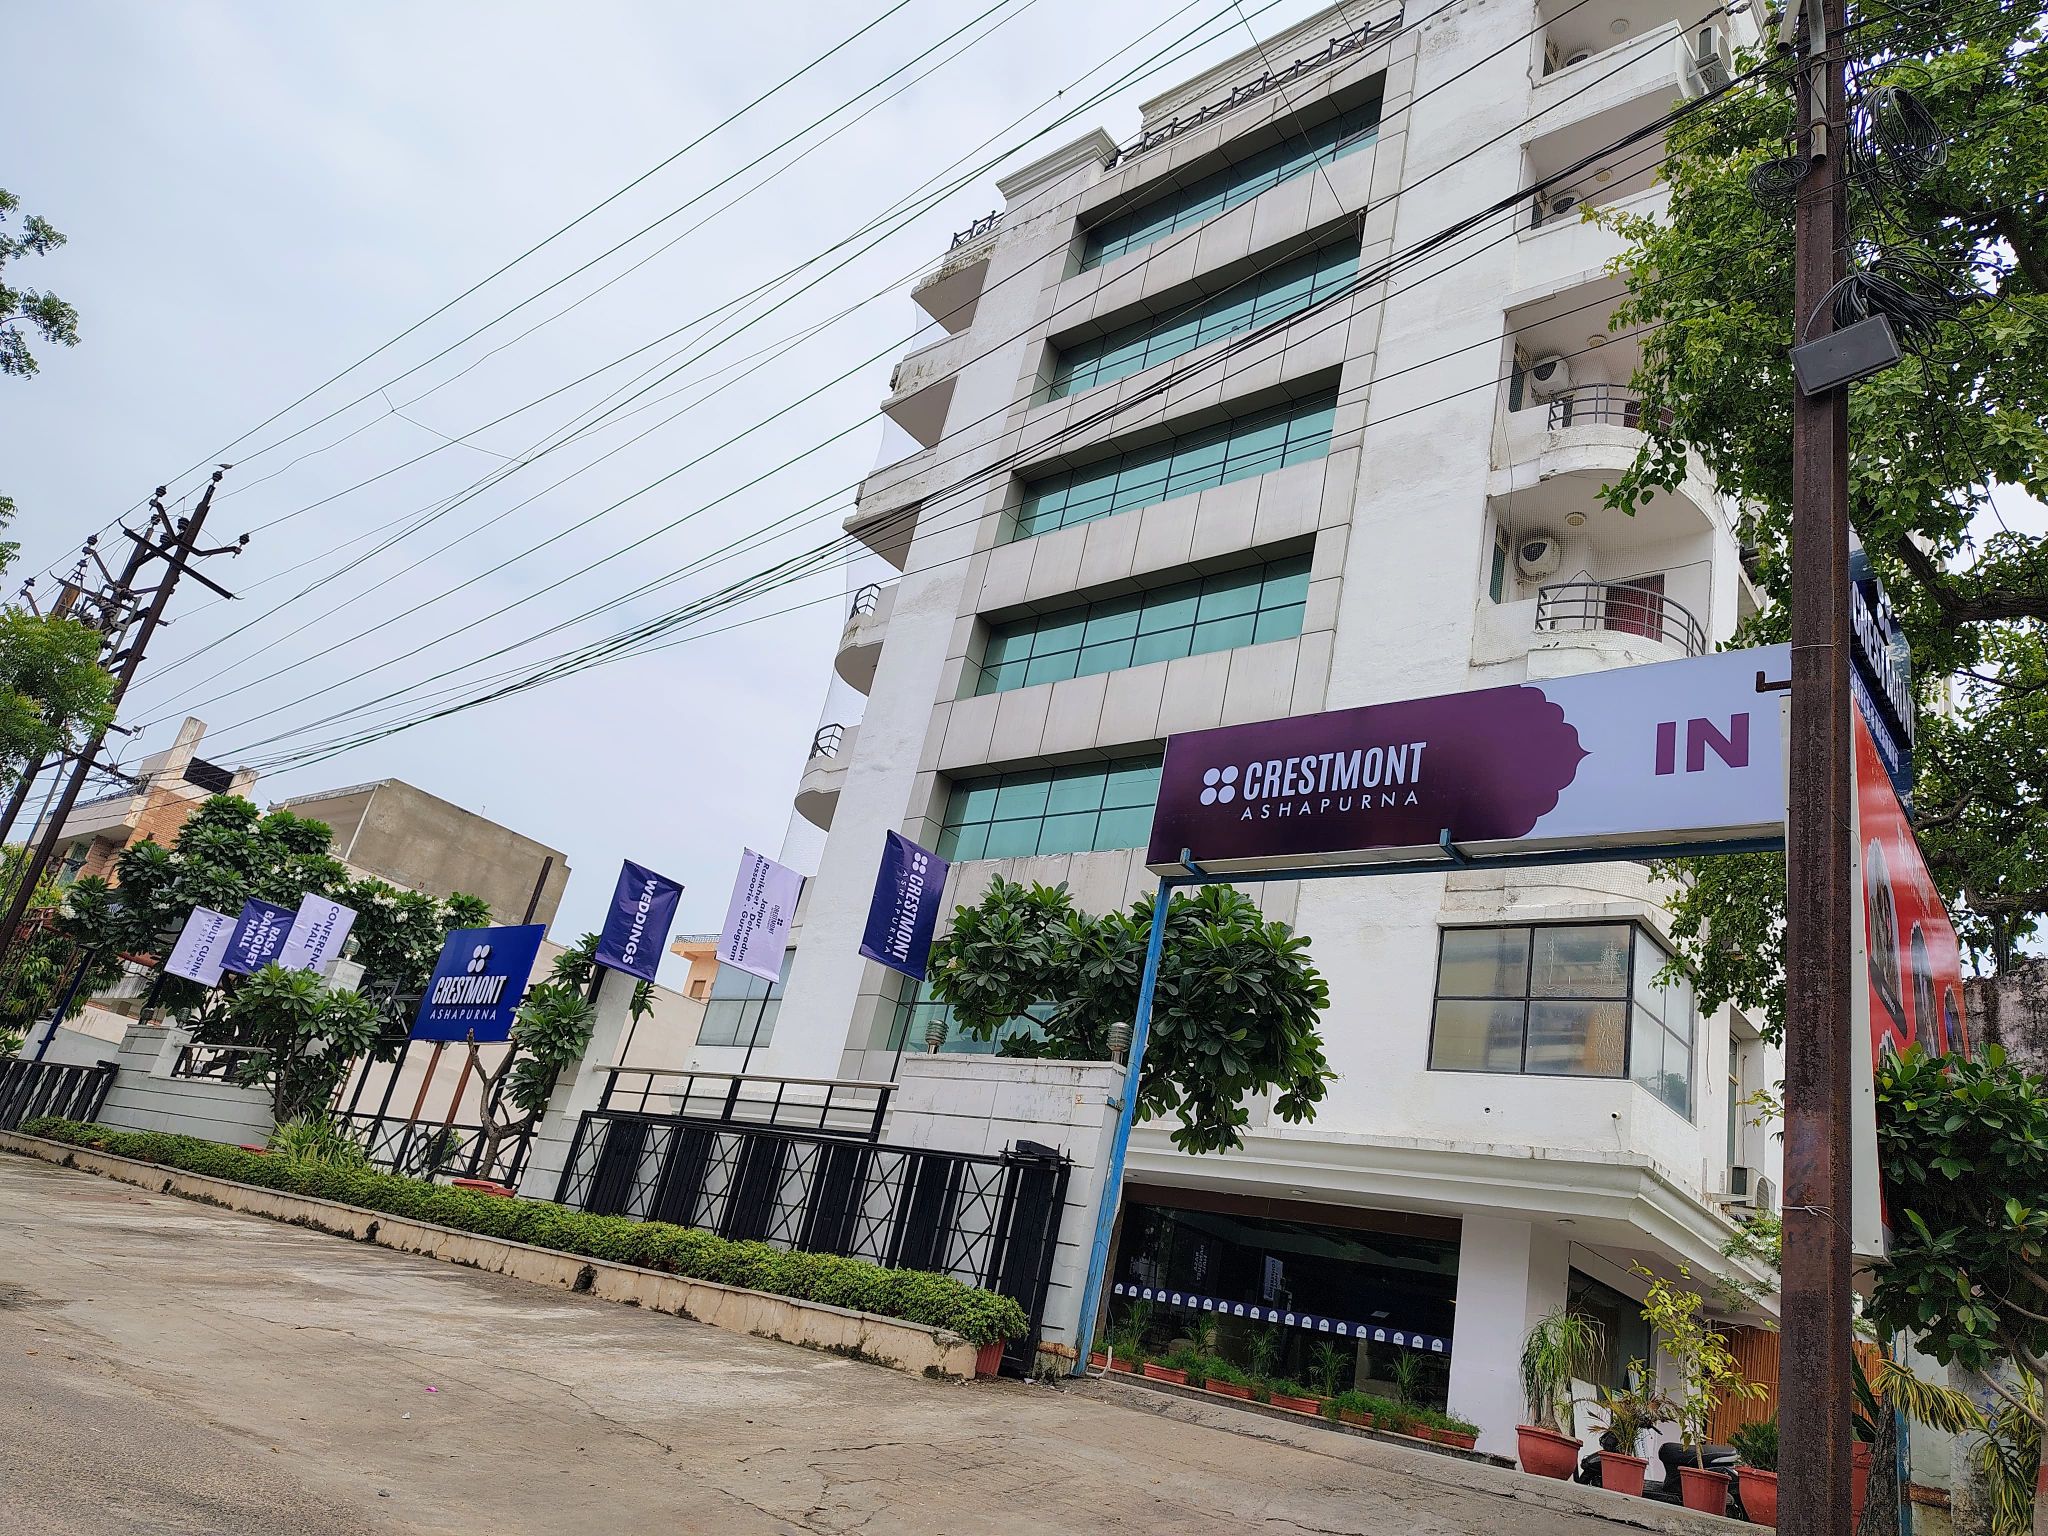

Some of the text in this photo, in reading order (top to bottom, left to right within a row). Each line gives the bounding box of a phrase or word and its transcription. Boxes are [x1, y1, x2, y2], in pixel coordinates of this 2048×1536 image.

[1243, 741, 1427, 801] CRESTMONT
[1655, 712, 1749, 776] IN
[1240, 790, 1419, 821] ASHAPURNA
[238, 918, 259, 949] HALL
[304, 922, 322, 949] HALL
[622, 879, 658, 965] WEDDINGS
[729, 854, 764, 961] Mussoorie Gurugram
[738, 862, 770, 961] Ranikhet Dehradun
[755, 898, 768, 929] Jaipur
[884, 869, 909, 954] ASHAPURNA
[892, 874, 925, 963] CRESTMONT
[184, 918, 212, 972] RESTAURANT
[189, 916, 224, 978] MULTI CUSINE
[245, 910, 275, 967] BANQUET
[261, 926, 281, 956] RASA
[307, 906, 339, 970] CONFERENC
[430, 1008, 497, 1021] ASHAPURNA
[431, 975, 507, 1005] CRESTMONT
